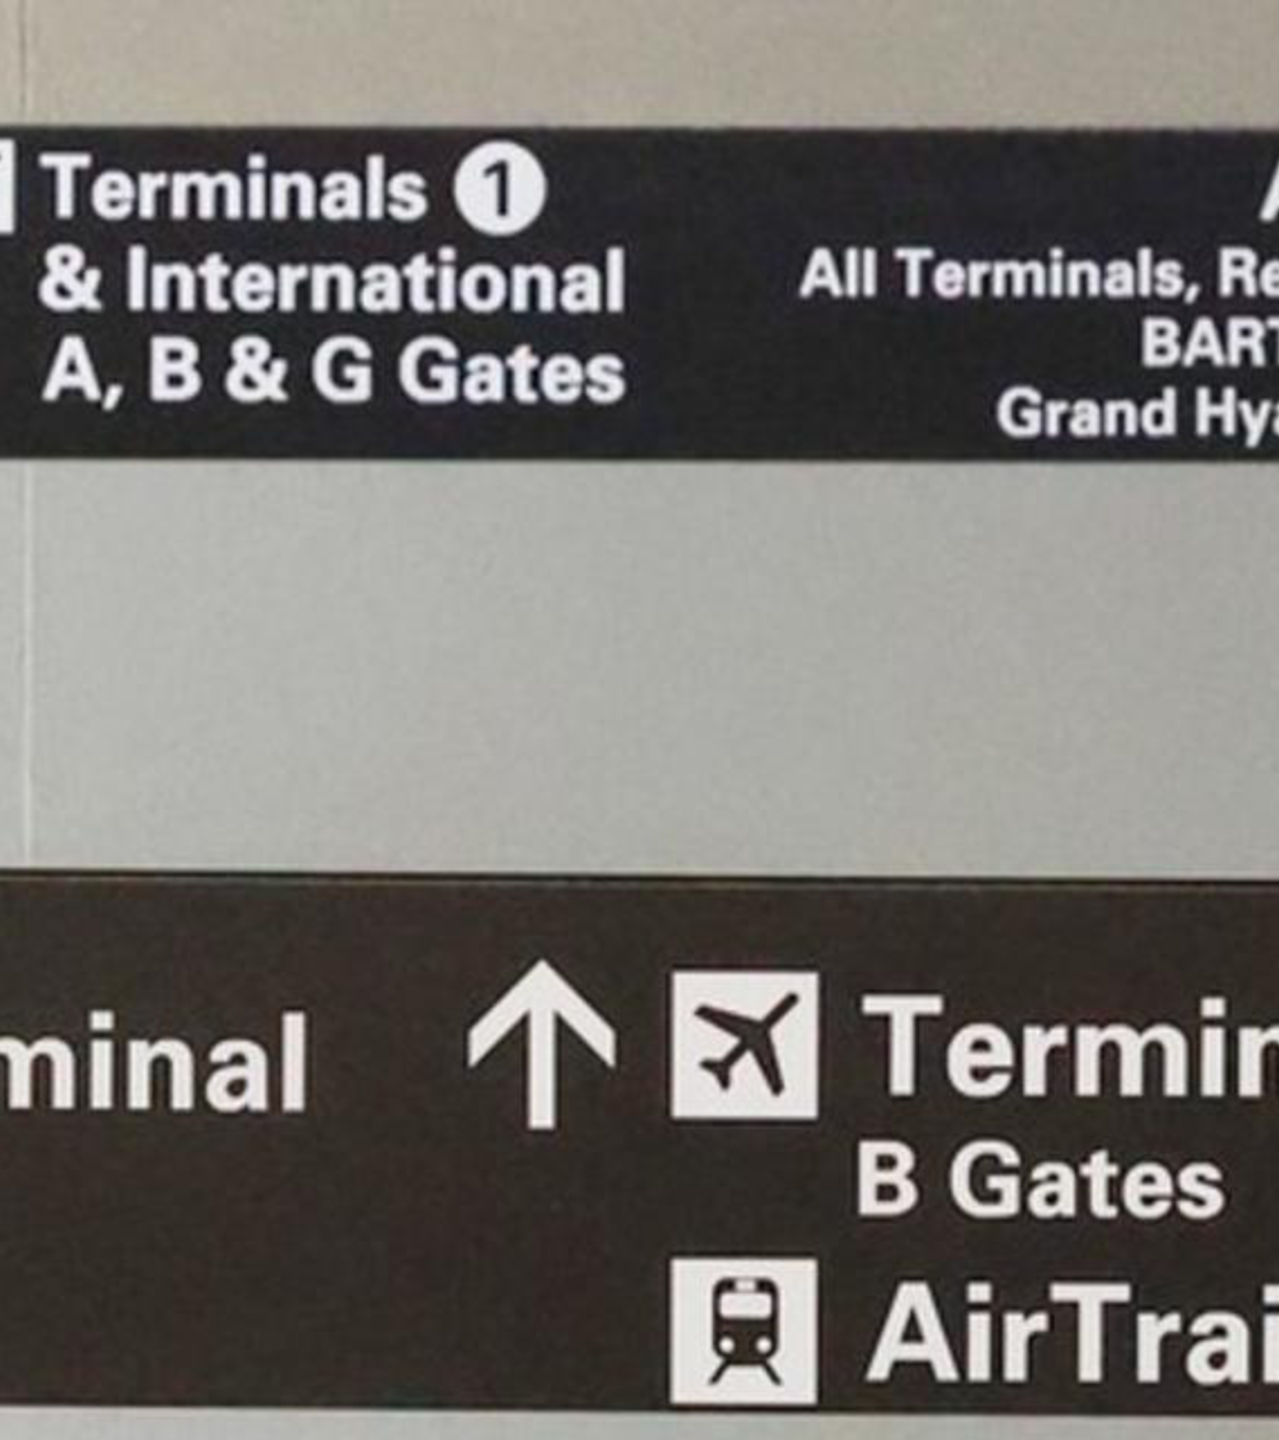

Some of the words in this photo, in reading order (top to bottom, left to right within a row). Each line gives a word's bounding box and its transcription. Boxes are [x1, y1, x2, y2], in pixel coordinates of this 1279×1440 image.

[38, 152, 428, 221] Terminals
[39, 243, 102, 312] &
[128, 245, 624, 313] International
[799, 247, 877, 298] All
[894, 247, 1200, 304] Terminals,
[42, 335, 123, 411] A,
[150, 335, 202, 402] B
[225, 335, 288, 403] &
[312, 335, 372, 403] G
[399, 335, 625, 404] Gates
[997, 386, 1177, 438] Grand
[858, 1140, 918, 1216] B
[950, 1140, 1224, 1219] Gates
